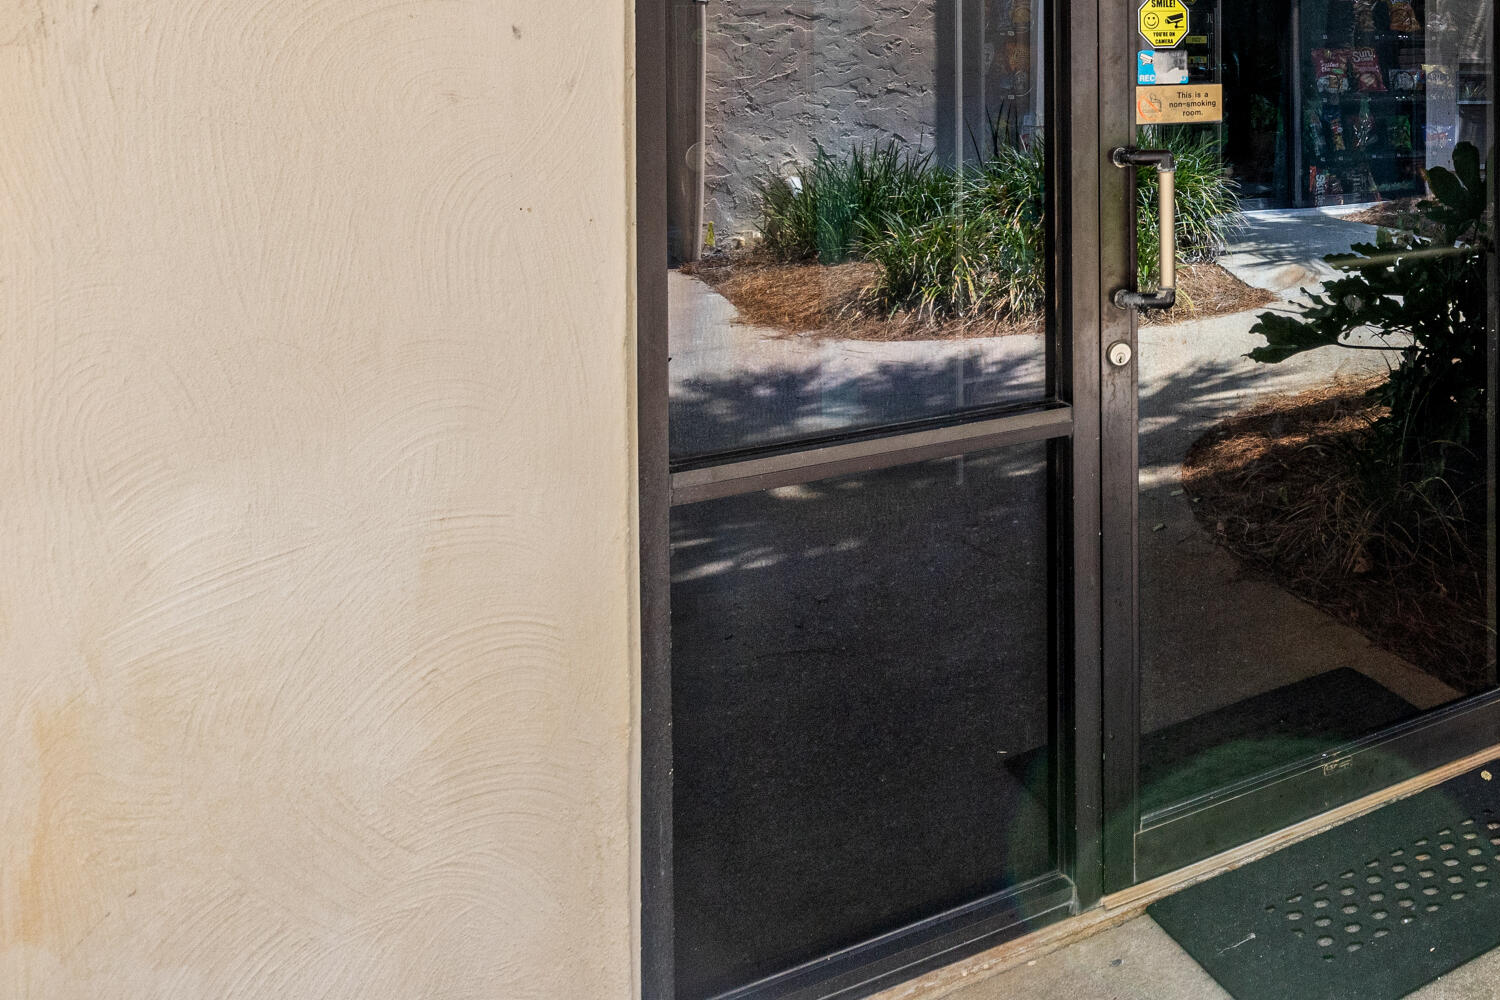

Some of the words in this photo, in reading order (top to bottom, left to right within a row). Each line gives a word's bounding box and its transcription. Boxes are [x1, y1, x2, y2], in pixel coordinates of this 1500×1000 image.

[1151, 0, 1176, 8] SMILE!
[1176, 91, 1192, 99] This
[1194, 90, 1202, 98] is
[1168, 99, 1217, 108] non-smoking
